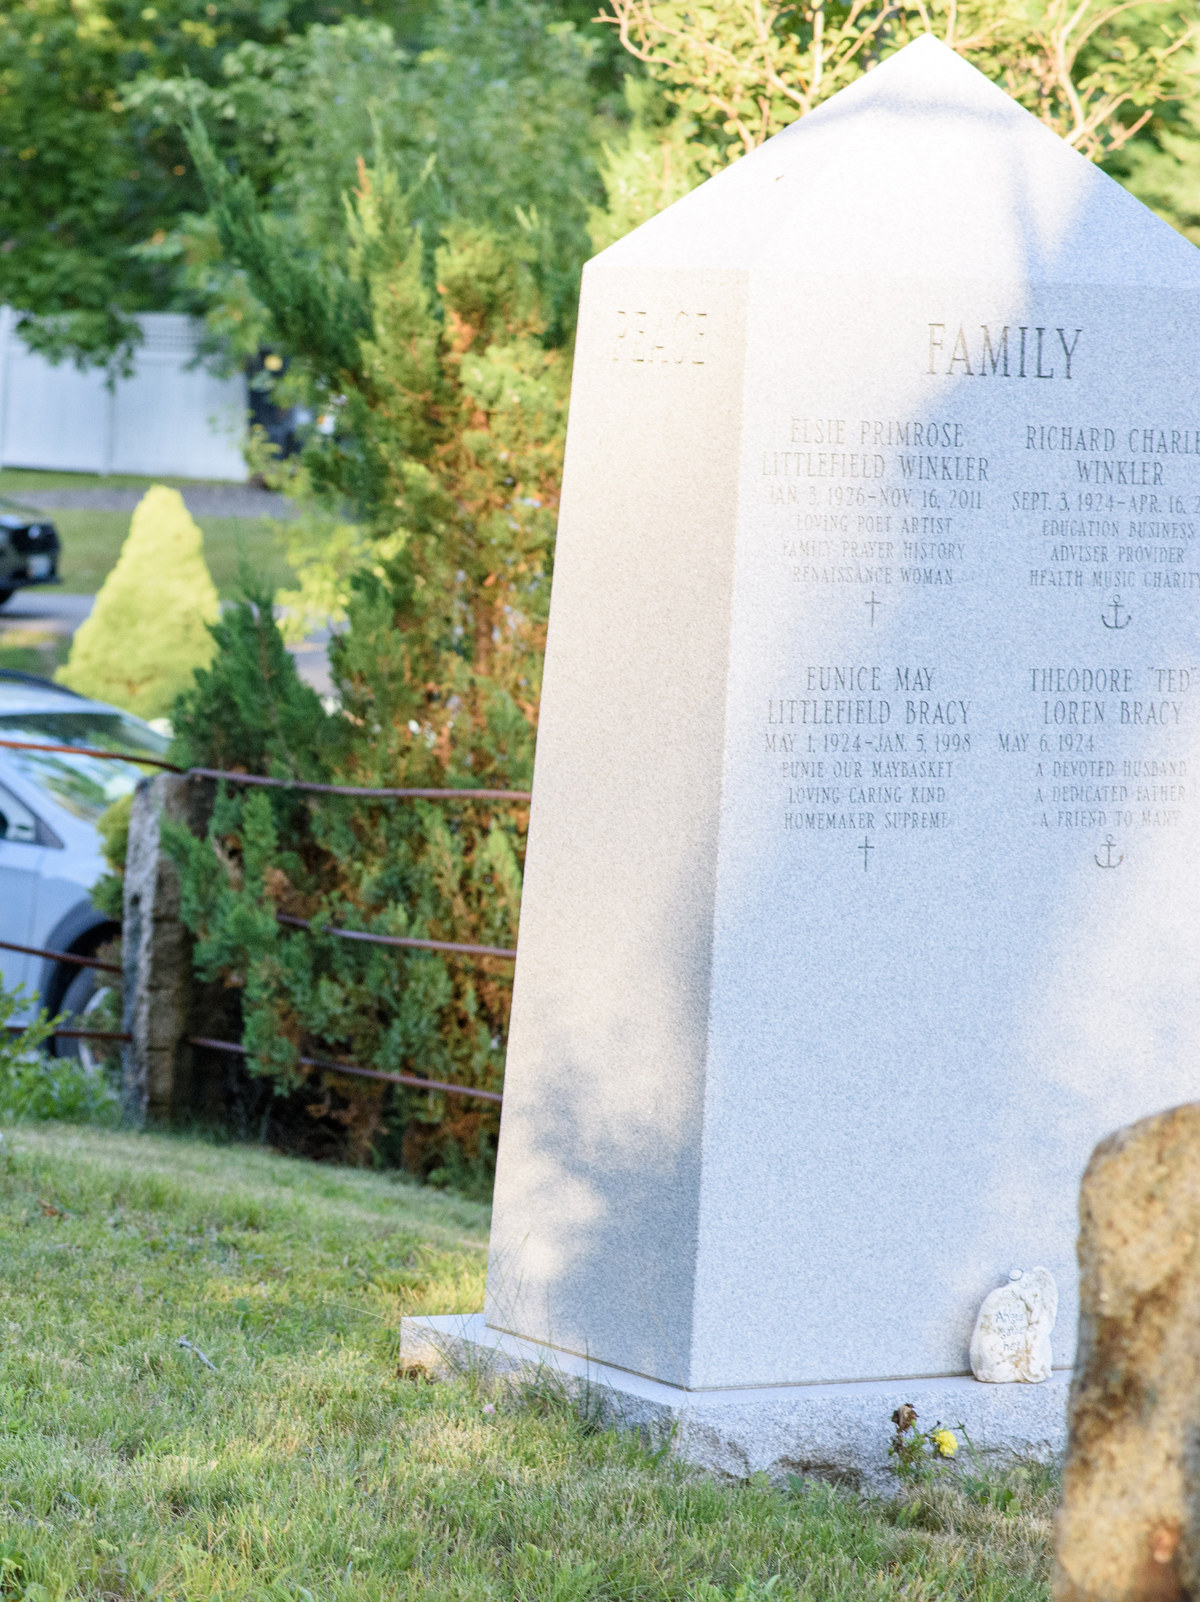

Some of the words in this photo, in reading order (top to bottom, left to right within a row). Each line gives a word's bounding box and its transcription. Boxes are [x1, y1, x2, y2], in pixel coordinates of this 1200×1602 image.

[926, 322, 1083, 380] FAMILY
[790, 418, 846, 444] ELSIE
[860, 420, 964, 448] PRIMROSE
[1025, 424, 1116, 451] RICHARD
[761, 452, 886, 480] LITTLEFIELD
[899, 454, 990, 481] WINKLER
[1076, 460, 1164, 486] WINKLER
[948, 490, 983, 510] 2011
[856, 514, 893, 533] POET
[901, 516, 953, 534] ARTIST
[1042, 520, 1119, 538] EDUCATION
[1128, 521, 1196, 540] BUSINESS
[842, 540, 894, 558] PRAYER
[903, 542, 966, 561] HISTORY
[1050, 546, 1109, 563] ADVISER
[1118, 546, 1186, 563] PROVIDER
[792, 565, 893, 584] RENAISSANCE
[901, 567, 954, 585] WOMAN
[1029, 570, 1083, 586] HEALTH
[1092, 570, 1136, 587] MUSIC
[806, 666, 881, 692] EUNICE
[894, 666, 936, 692] MAY
[1029, 668, 1133, 692] THEODORE
[767, 699, 892, 725] LITTLEFIELD
[905, 700, 972, 725] BRACY
[1043, 700, 1105, 725] LOREN
[1120, 700, 1184, 725] BRACY
[764, 733, 797, 752] MAY
[935, 734, 972, 752] 1998
[998, 733, 1030, 752] MAY
[1058, 734, 1094, 752] 1924
[833, 762, 863, 778] OUR
[872, 761, 954, 778] MAYBASKET
[1035, 762, 1044, 777] A
[1052, 761, 1114, 778] DEVOTED
[1123, 761, 1187, 778] HUSBAND
[788, 787, 841, 804] LOVING
[848, 787, 902, 804] CARING
[911, 787, 946, 803] KIND
[1034, 787, 1044, 803] A
[1052, 786, 1128, 802] DEDICATED
[1136, 786, 1186, 802] FATHER
[784, 813, 875, 830] HOMEMAKER
[884, 813, 950, 830] SUPREME
[1039, 812, 1048, 827] A
[1057, 811, 1106, 827] FRIEND
[1116, 811, 1133, 827] TO
[1141, 811, 1182, 827] MANY
